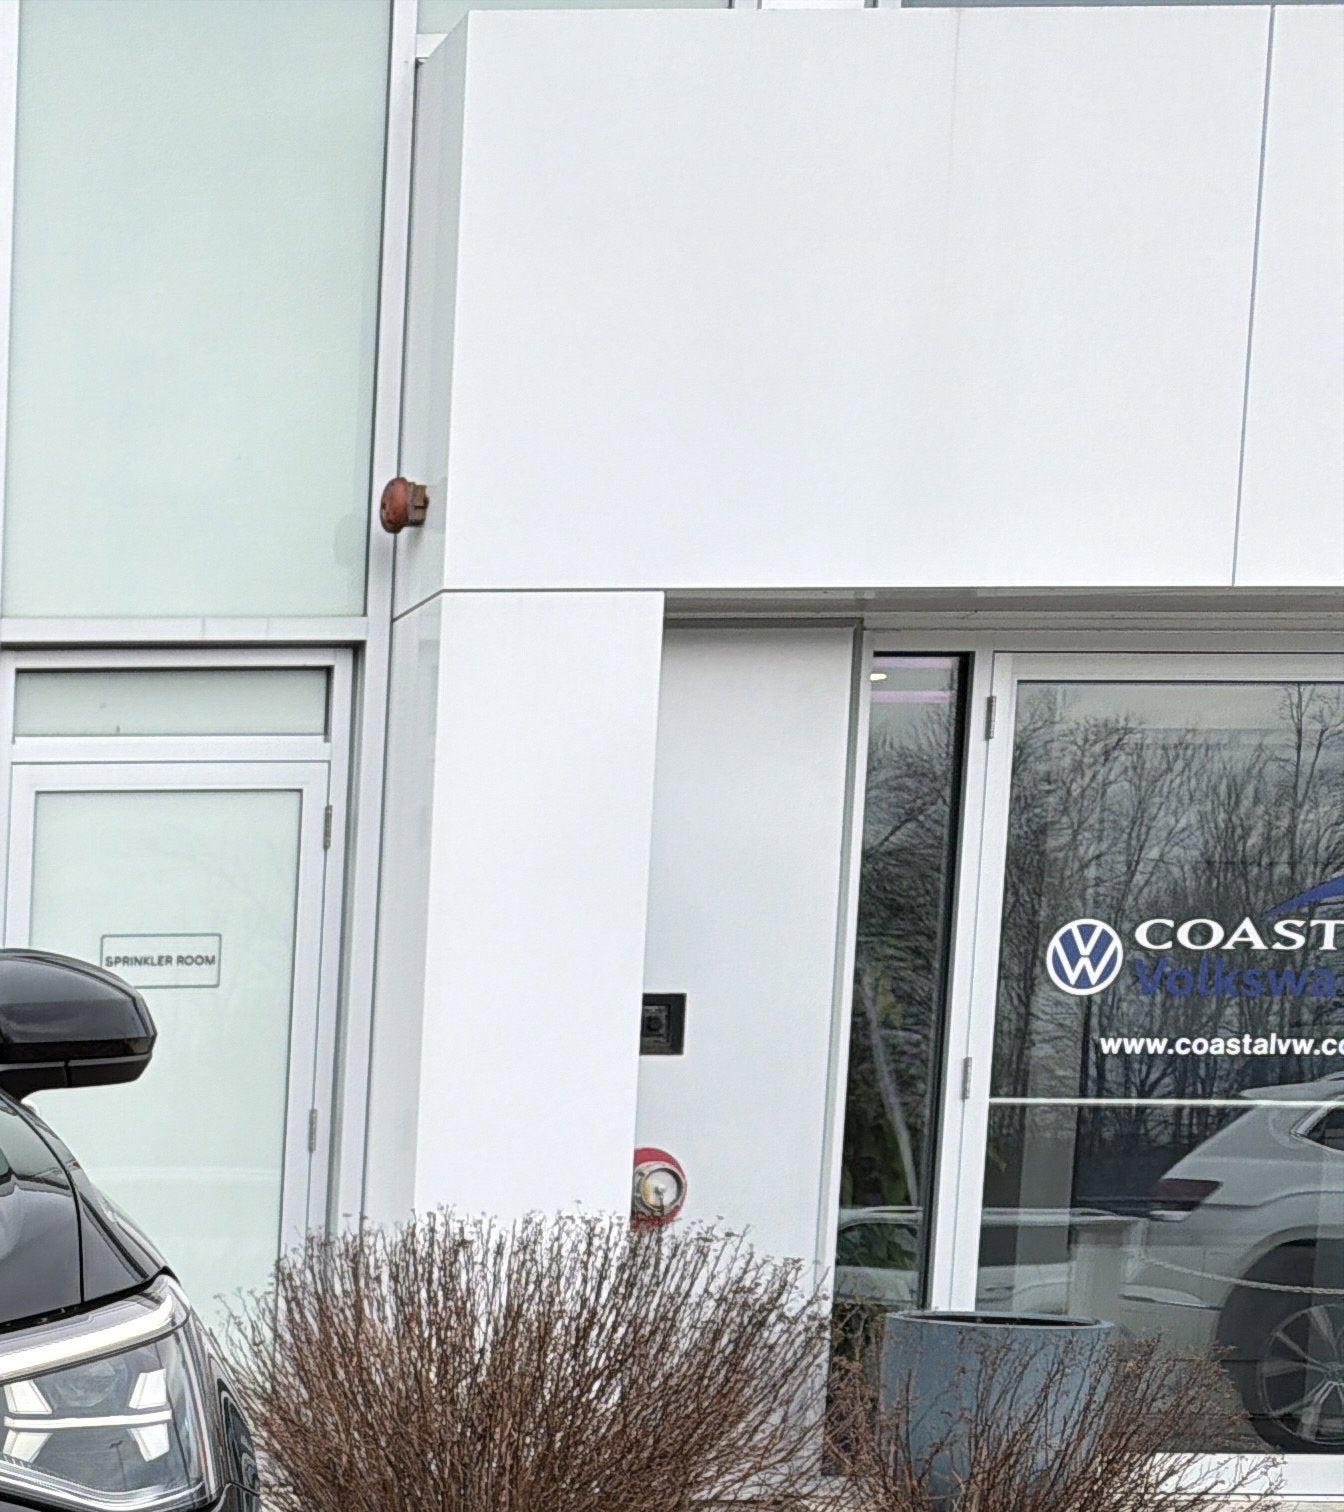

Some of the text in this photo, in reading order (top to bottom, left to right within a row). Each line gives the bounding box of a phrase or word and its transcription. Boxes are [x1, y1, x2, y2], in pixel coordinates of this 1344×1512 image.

[1134, 916, 1344, 951] COAST
[105, 954, 216, 967] SPRINKLER ROOM
[1134, 957, 1344, 998] Volkswa
